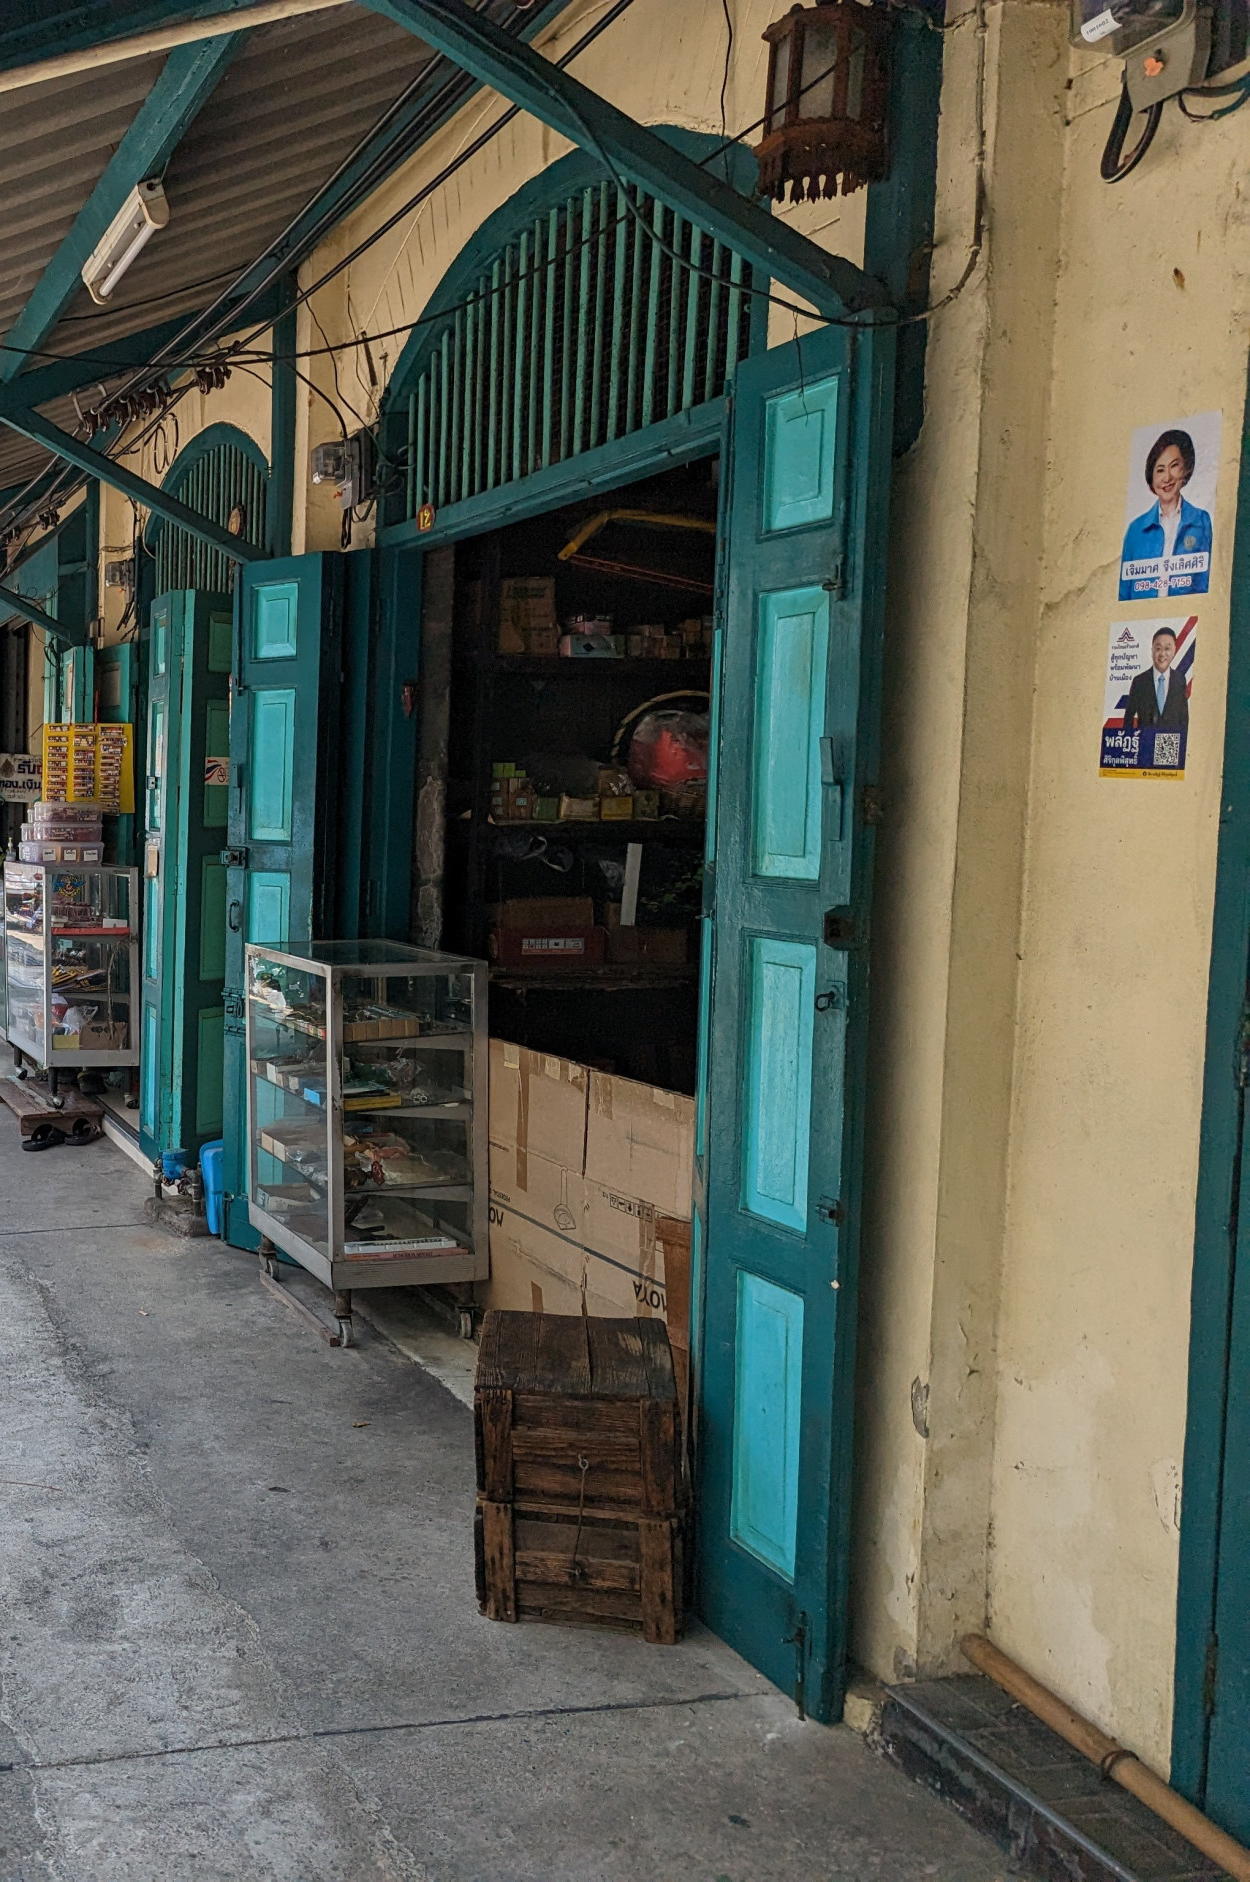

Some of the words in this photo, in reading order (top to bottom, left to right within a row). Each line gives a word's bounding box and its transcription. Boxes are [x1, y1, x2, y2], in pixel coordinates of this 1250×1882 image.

[419, 508, 431, 530] 12
[1125, 563, 1159, 577] เจิมมาศ
[1134, 577, 1192, 591] 098-428-7156
